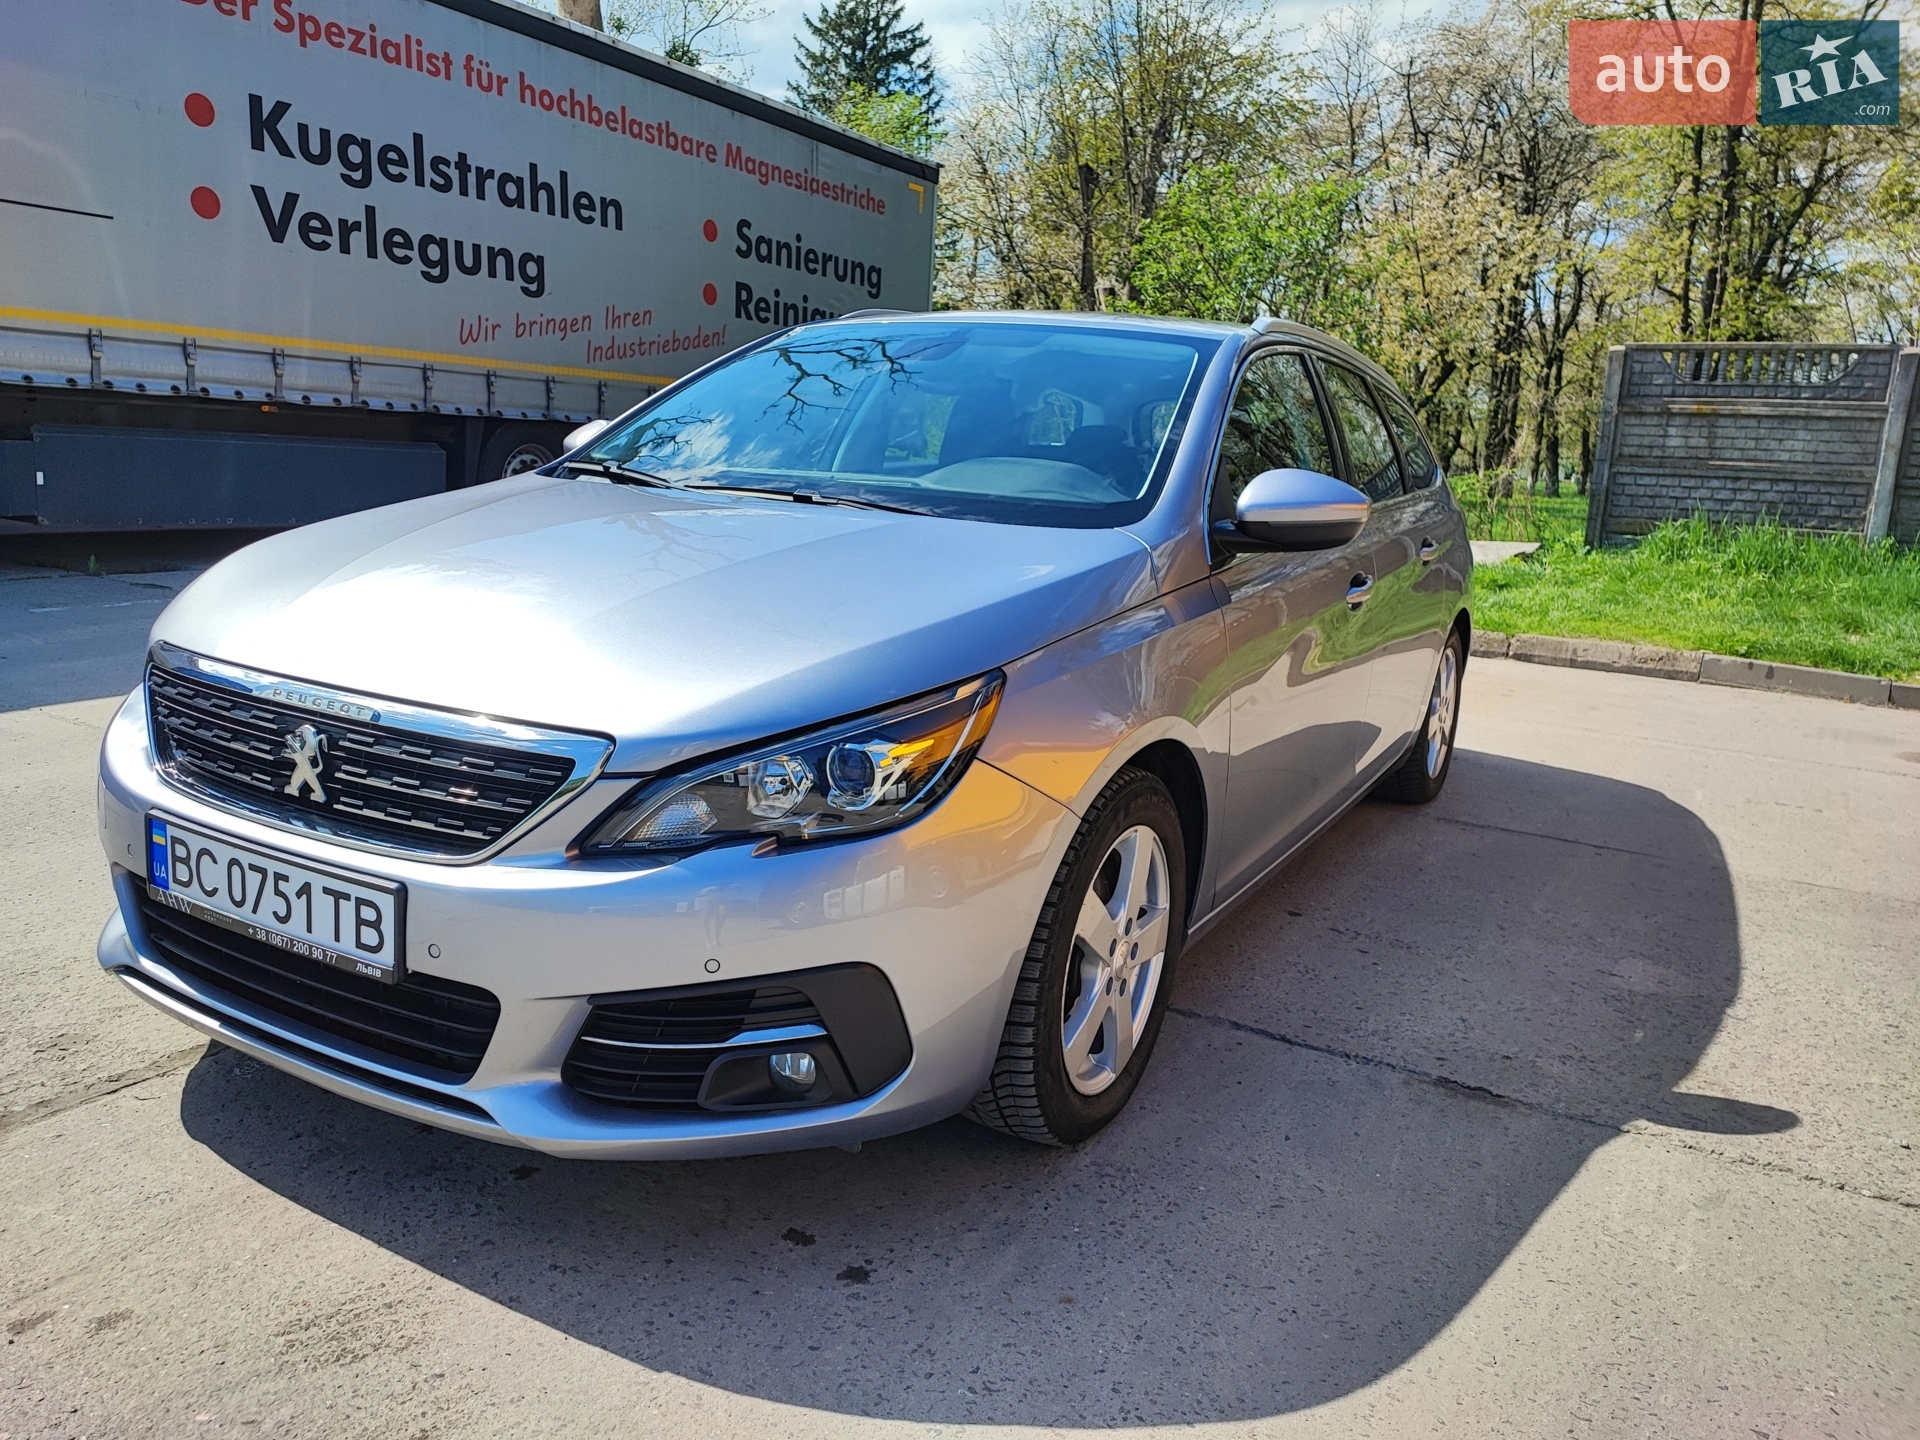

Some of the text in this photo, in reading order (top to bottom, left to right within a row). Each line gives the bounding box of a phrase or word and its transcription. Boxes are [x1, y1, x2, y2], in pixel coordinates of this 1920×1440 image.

[178, 0, 887, 216] er Spezialist für hochbelastbare Magnesiaestriche
[248, 92, 624, 231] Kugelstrahlen
[250, 184, 546, 299] Verlegung
[735, 218, 882, 299] Sanierung
[458, 304, 653, 346] Wir bringen Ihren
[735, 281, 845, 327] Reini
[586, 324, 727, 365] Industrieboden!
[272, 688, 366, 718] PEUGEOT
[153, 861, 168, 880] UA
[156, 890, 194, 915] AHW
[268, 932, 291, 949] (067)
[293, 941, 310, 956] 200
[311, 949, 324, 960] 90
[325, 951, 338, 965] 77
